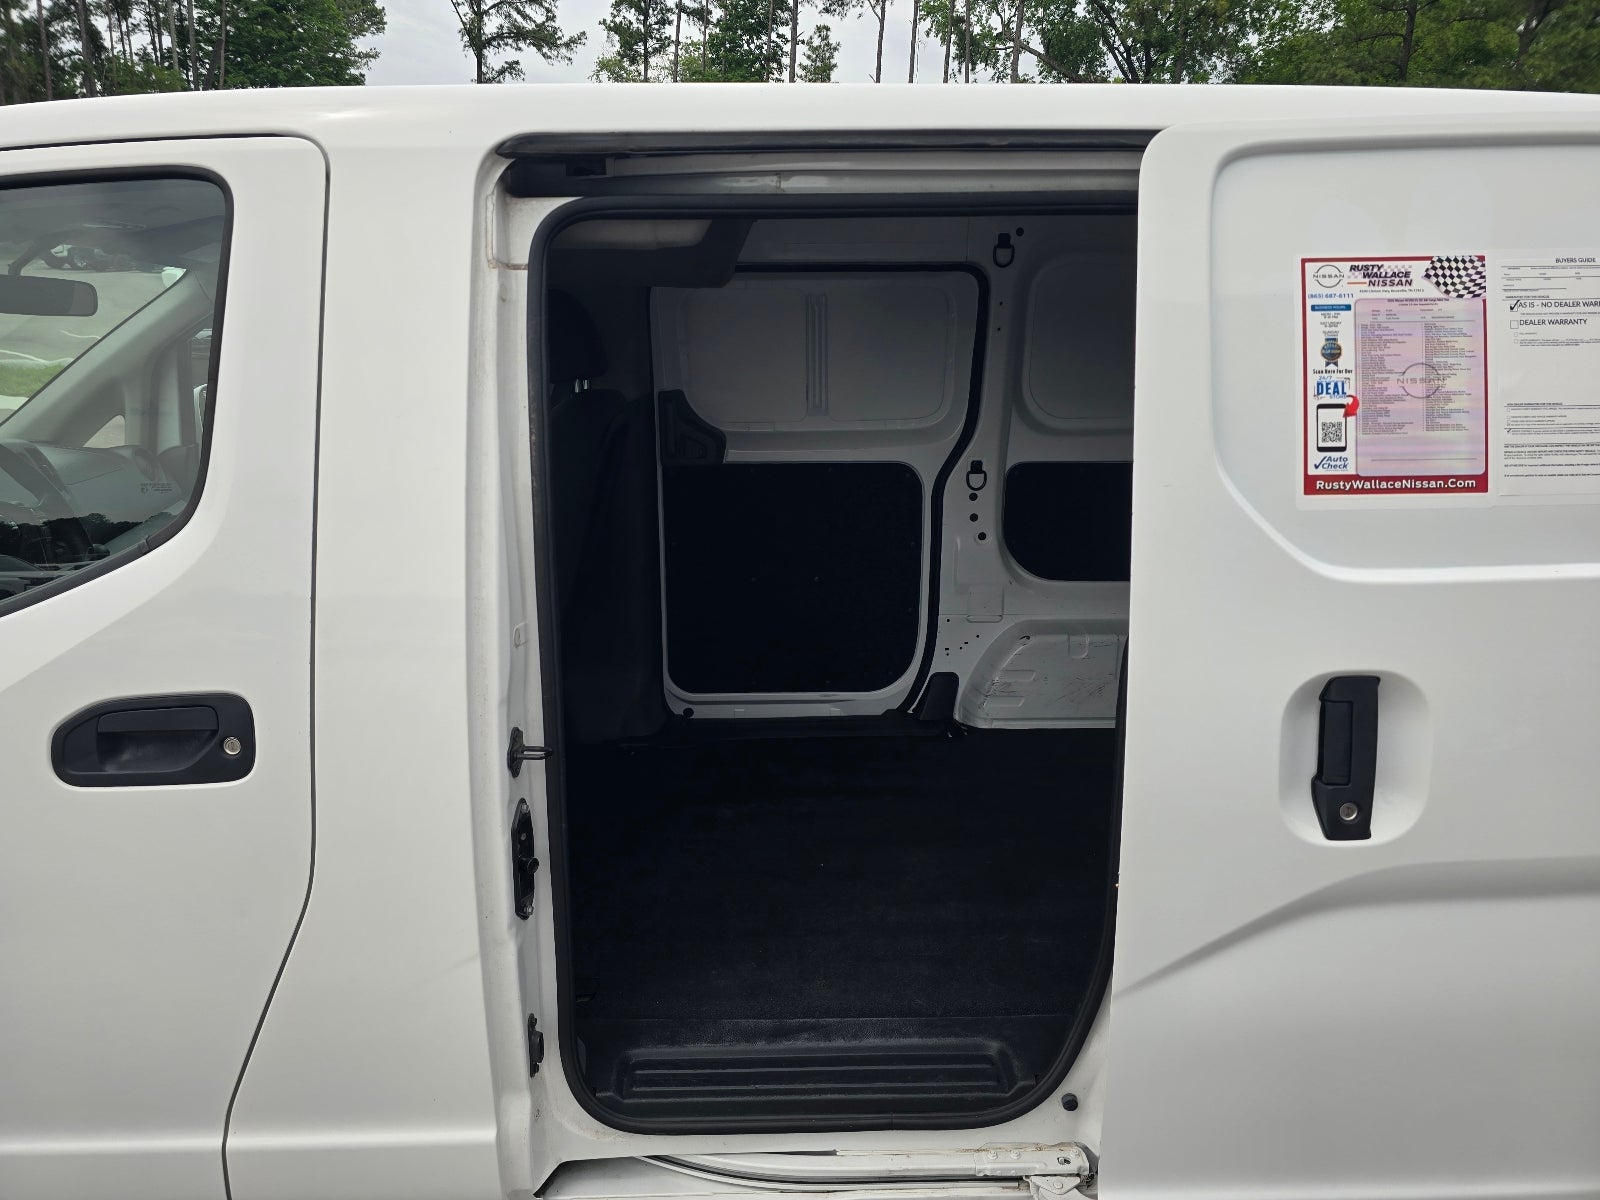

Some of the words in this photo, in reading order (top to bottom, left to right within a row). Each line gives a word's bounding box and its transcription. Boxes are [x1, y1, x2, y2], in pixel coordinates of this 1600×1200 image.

[1350, 264, 1384, 272] RUSTY
[1362, 271, 1411, 279] WALLACE
[1368, 279, 1413, 287] NISSAN
[1316, 380, 1347, 395] DEAL
[1321, 462, 1348, 470] Check
[1316, 478, 1476, 492] RustyWallaceNissan.Com
